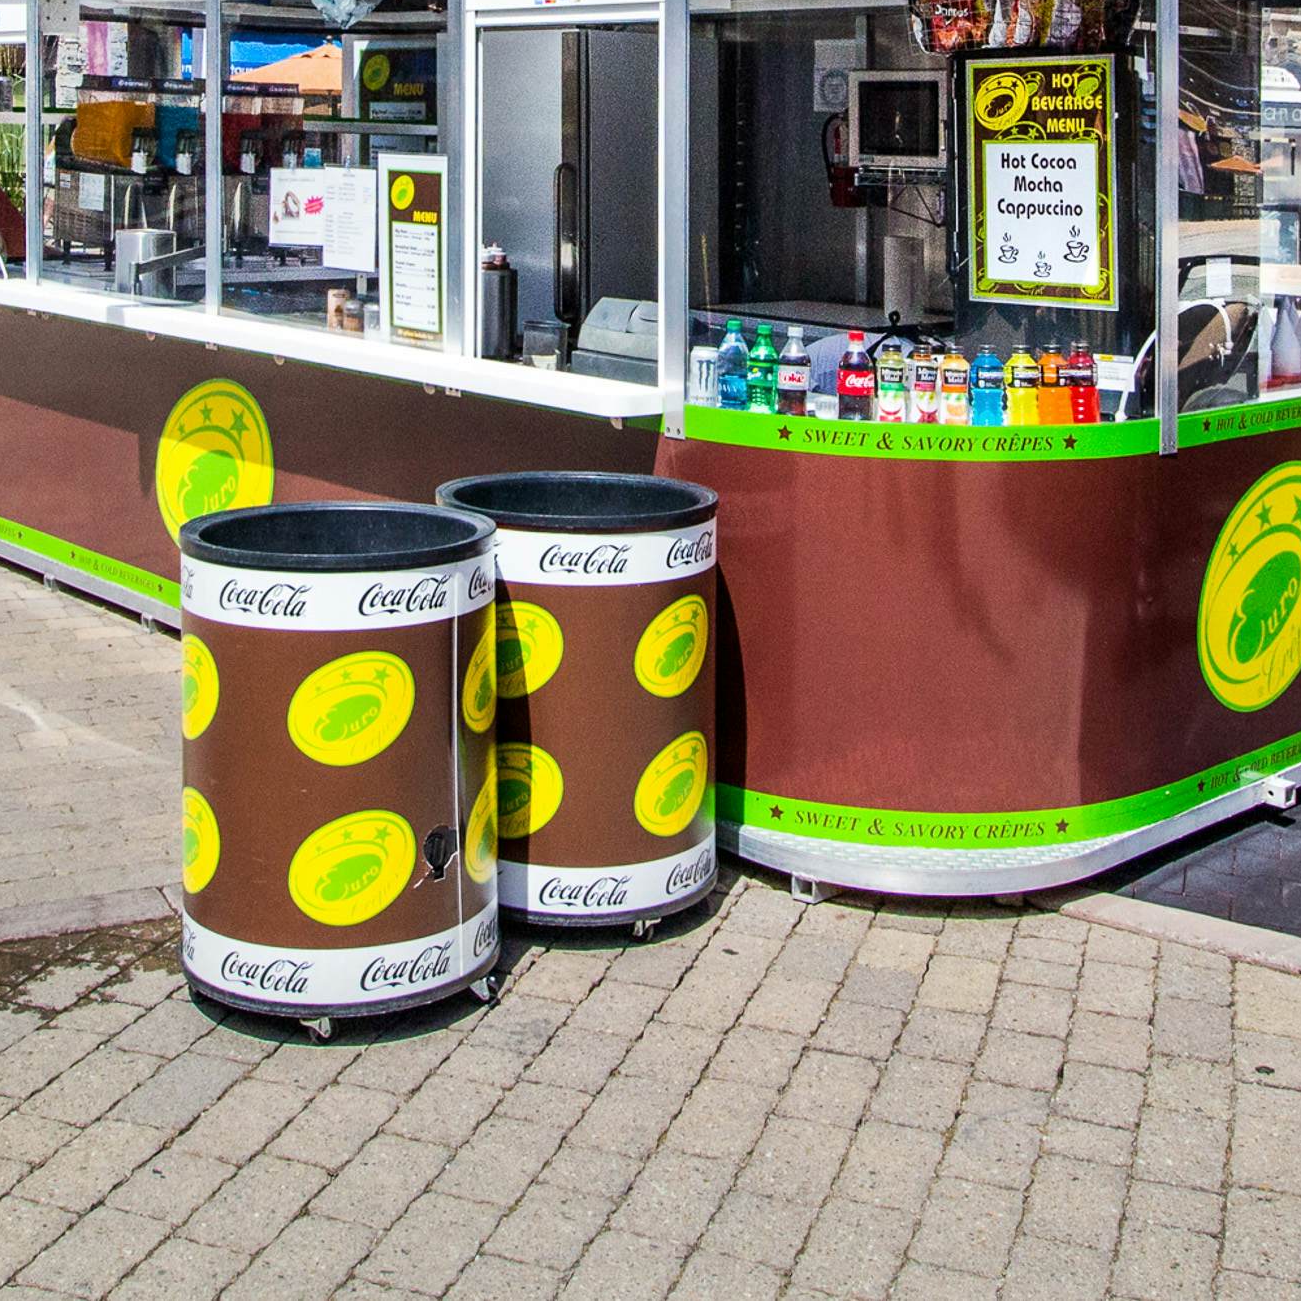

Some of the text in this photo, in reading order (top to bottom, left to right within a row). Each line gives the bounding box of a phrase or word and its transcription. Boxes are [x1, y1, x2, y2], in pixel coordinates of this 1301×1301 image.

[393, 83, 424, 96] MENU
[1052, 73, 1080, 89] HOT
[1031, 95, 1103, 111] BEVERAGE
[1047, 118, 1086, 133] MENU
[1001, 153, 1077, 169] Hot Cocoa
[1014, 176, 1063, 193] Mocha
[413, 211, 437, 223] MENU
[997, 199, 1083, 219] Cappuccino
[1216, 416, 1235, 432] HOT
[1237, 412, 1247, 430] &
[1251, 410, 1273, 426] COLD
[803, 428, 1053, 452] SWEET & SAVORY CRÊPES
[540, 544, 632, 574] Coca-Cola
[220, 578, 313, 617] Coca-Cola
[359, 574, 451, 616] Coca-Cola
[1230, 578, 1297, 662] Euro
[794, 810, 1045, 840] SWEET & SAVORY CRÊPES
[539, 876, 632, 907] Coca-Cola
[221, 951, 314, 994] Coca-Cola
[360, 940, 454, 991] Coca-Cola
